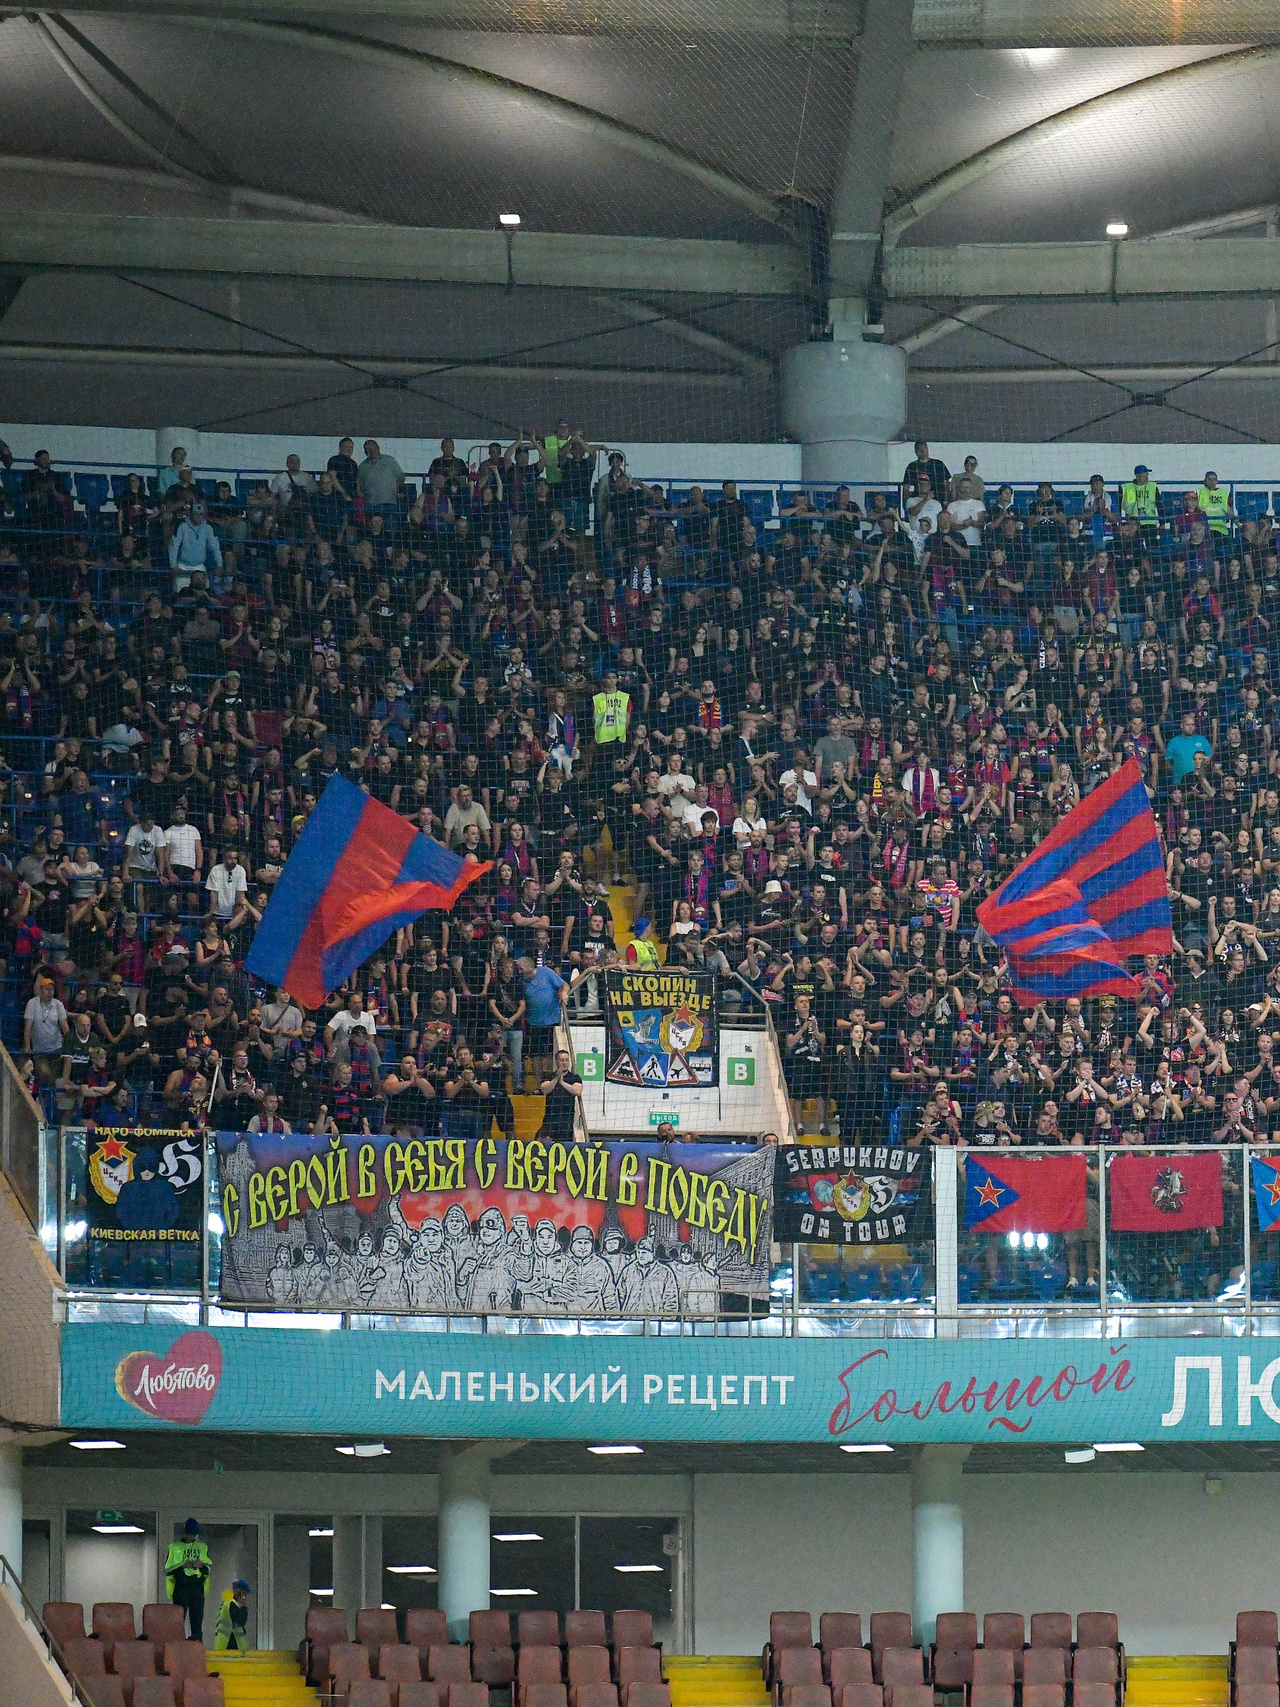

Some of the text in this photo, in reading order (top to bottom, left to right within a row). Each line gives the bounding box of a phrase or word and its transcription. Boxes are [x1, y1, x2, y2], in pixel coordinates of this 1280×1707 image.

[622, 976, 697, 993] СКОПИН
[609, 990, 713, 1011] НА ВЫЕЗДЕ
[671, 1028, 687, 1046] ЦСКА
[785, 1146, 921, 1173] SERPUKHOV
[103, 1167, 123, 1187] ЦСКА
[223, 1136, 768, 1266] С ВЕРОЙ В СЕБЯ С ВЕРОЙ В ПОБЕДУ
[842, 1194, 858, 1209] ЦСКА
[91, 1227, 200, 1240] КИЕВСКАЯ ВЕТКА
[800, 1213, 907, 1242] ON TOUR
[133, 1362, 215, 1409] Любятово
[375, 1365, 628, 1404] МАЛЕНЬКИЙ
[644, 1375, 795, 1411] РЕЦЕПТ
